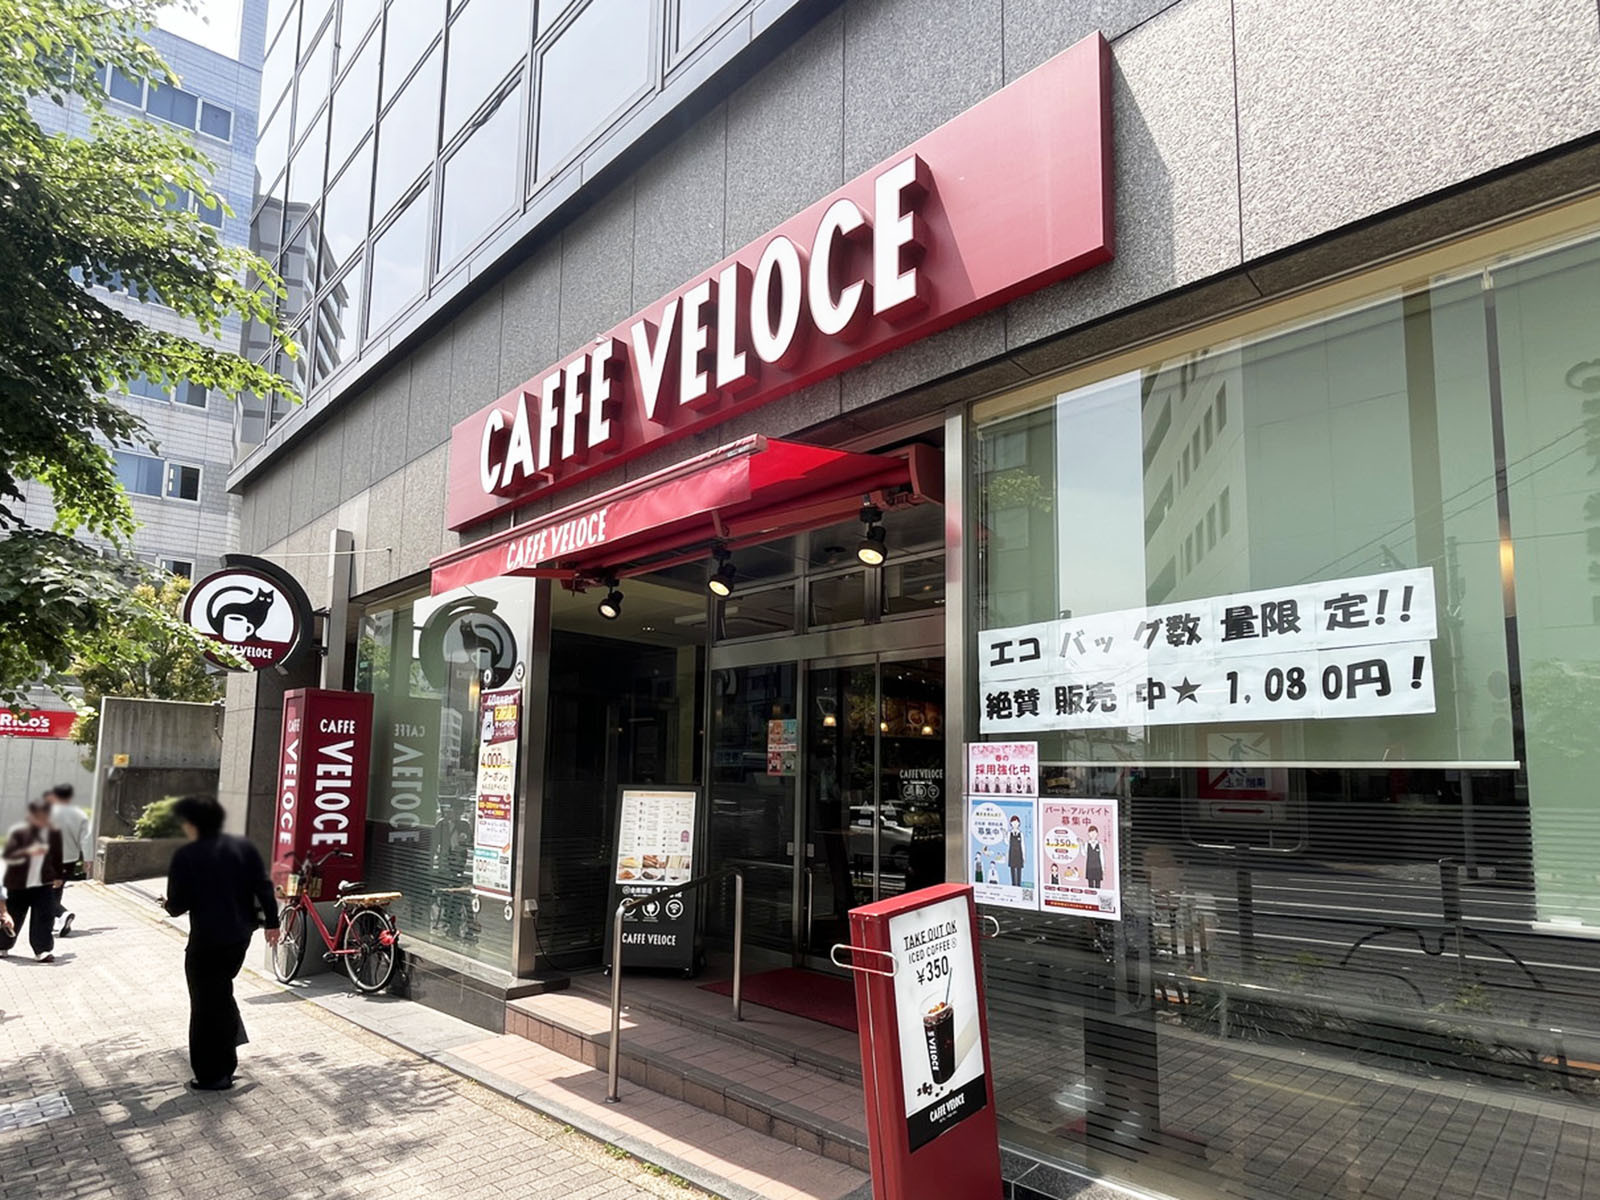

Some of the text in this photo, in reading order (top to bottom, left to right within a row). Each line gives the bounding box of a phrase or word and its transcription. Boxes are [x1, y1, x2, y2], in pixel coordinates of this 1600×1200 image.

[630, 154, 917, 421] VELOCE
[550, 508, 608, 556] VELOCE
[240, 645, 273, 659] VELOCE
[319, 718, 356, 735] CAFFE
[975, 764, 1031, 776] 採用強化中
[279, 738, 300, 845] VELOCE
[311, 740, 355, 846] VELOCE
[647, 933, 677, 947] VELOCE
[904, 930, 926, 951] TAKE
[928, 924, 944, 941] OUT
[908, 949, 926, 964] ICED
[926, 939, 951, 957] COFFEE
[916, 955, 949, 985] ¥350
